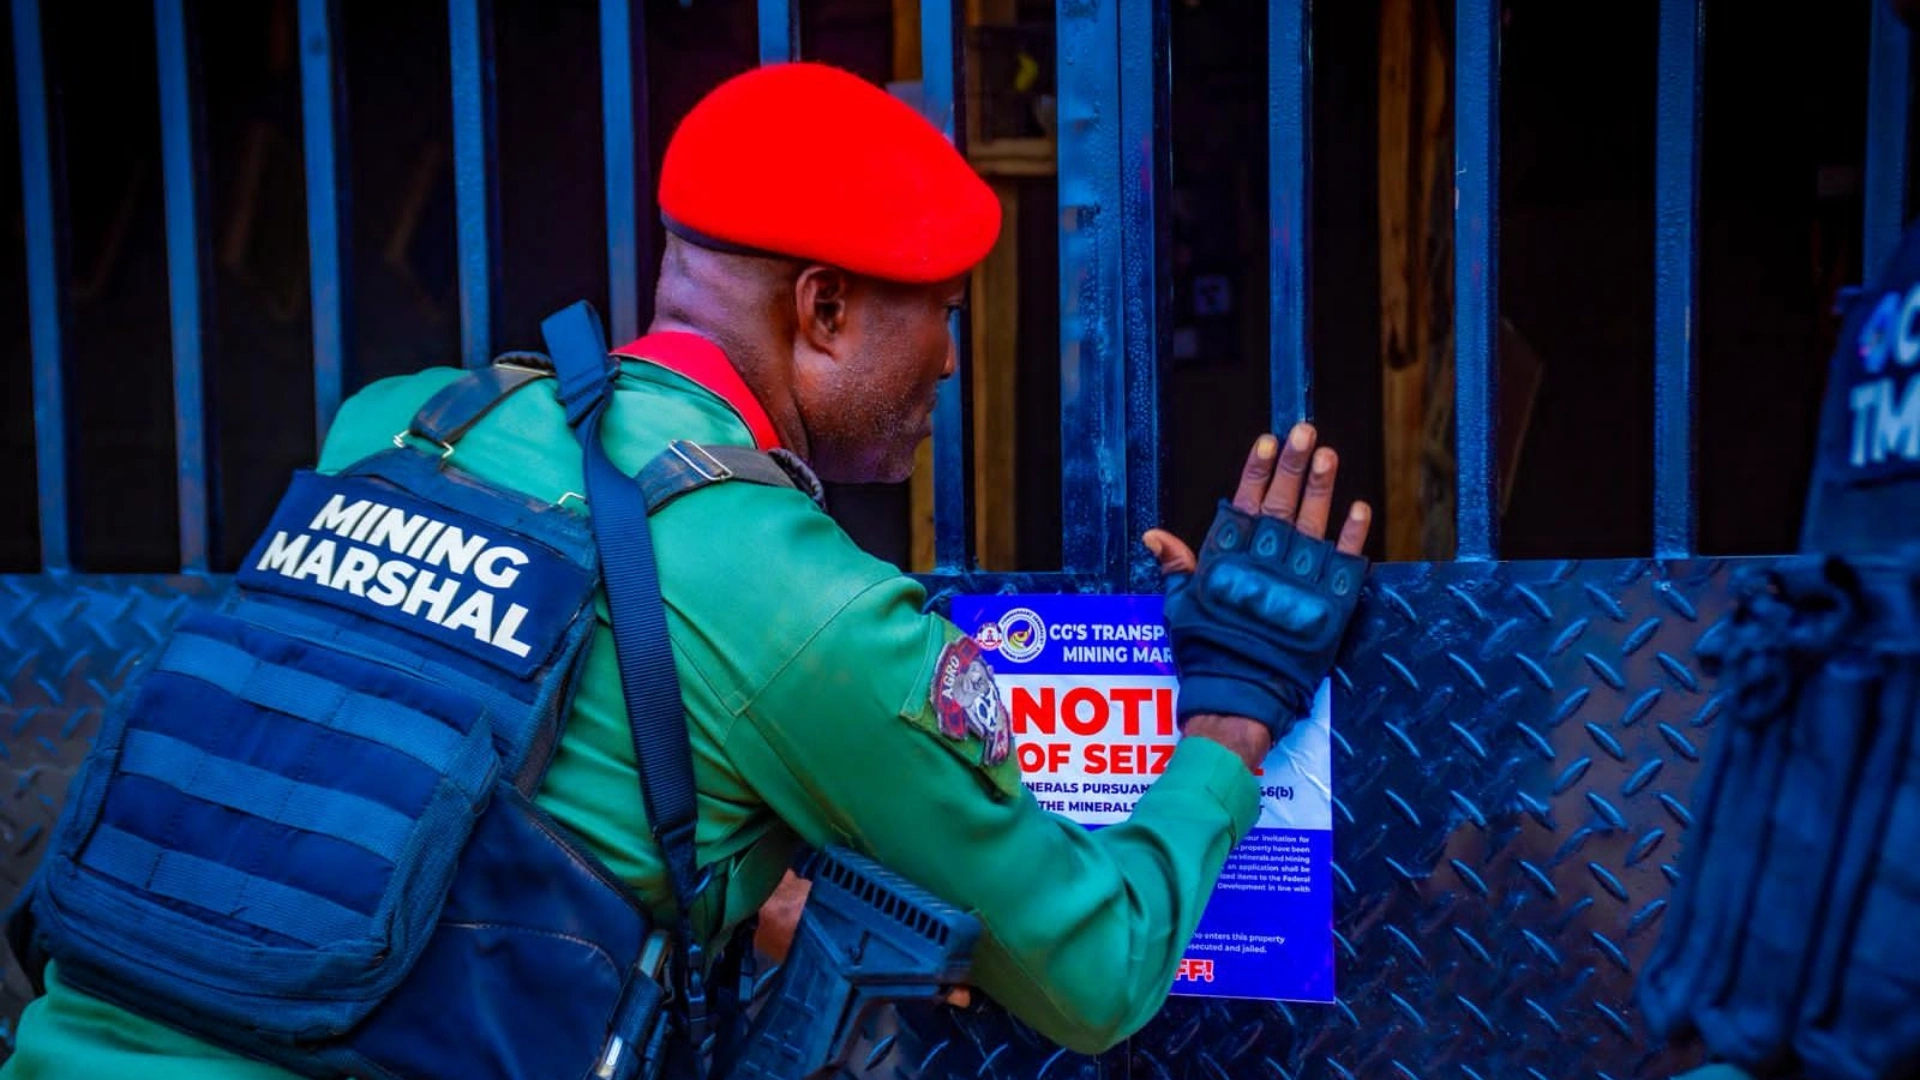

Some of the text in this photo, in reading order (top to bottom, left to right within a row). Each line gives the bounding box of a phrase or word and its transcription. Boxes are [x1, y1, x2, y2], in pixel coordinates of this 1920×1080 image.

[309, 494, 530, 589] MINING
[256, 531, 532, 658] MARSHAL
[1049, 623, 1167, 641] CG'S TRANSP
[1063, 646, 1173, 663] MINING MAR
[941, 655, 960, 700] AGRO
[1011, 687, 1173, 736] NOTI
[1017, 742, 1070, 773] OF
[1021, 782, 1078, 793] NERALS
[1083, 783, 1151, 795] PURSUAN
[1037, 800, 1064, 812] THE
[1262, 834, 1297, 843] invitation
[1299, 835, 1310, 843] for
[1240, 844, 1271, 853] property
[1273, 845, 1290, 853] have
[1238, 854, 1269, 862] Minerals
[1285, 855, 1310, 865] Mining
[1238, 863, 1279, 873] application
[1281, 865, 1299, 873] shall
[1300, 865, 1310, 873] be
[1268, 874, 1281, 882] the
[1283, 875, 1311, 883] Federal
[1217, 882, 1266, 892] Development
[1293, 885, 1311, 893] with
[1204, 932, 1231, 941] enters
[1232, 932, 1248, 942] this
[1249, 934, 1285, 945] property
[1224, 943, 1241, 952] and
[1242, 943, 1267, 954] jailed.
